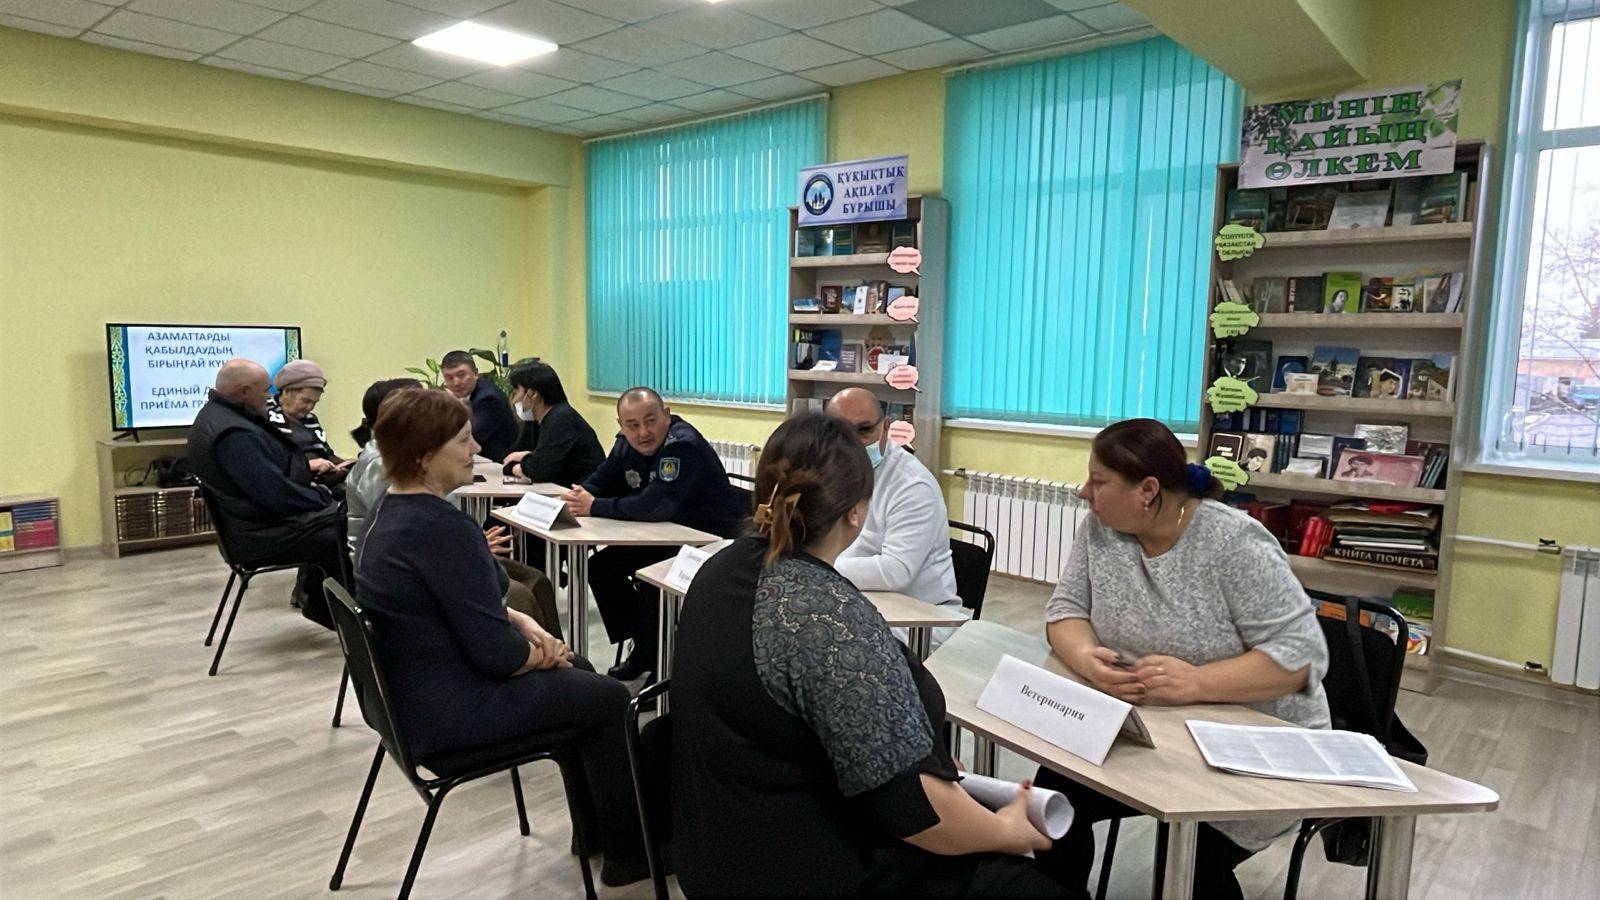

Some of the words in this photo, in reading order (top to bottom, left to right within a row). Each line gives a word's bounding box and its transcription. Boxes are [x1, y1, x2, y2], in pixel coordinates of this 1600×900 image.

[1265, 149, 1424, 181] ӨЛКЕМ
[843, 183, 896, 199] АҚПАРАТ
[147, 332, 230, 343] АЗАМАТТАРДЫ
[145, 346, 234, 356] ҚАБЫЛДАУДЫҢ
[148, 358, 205, 369] БІРЫҢҒАЙ
[151, 385, 200, 397] ЕДИНЫЙ
[140, 400, 188, 410] ПРИЁМА
[1334, 547, 1372, 560] КНИГА
[1376, 553, 1424, 568] ПОЧЕТА
[1020, 684, 1085, 721] Ветеринария
